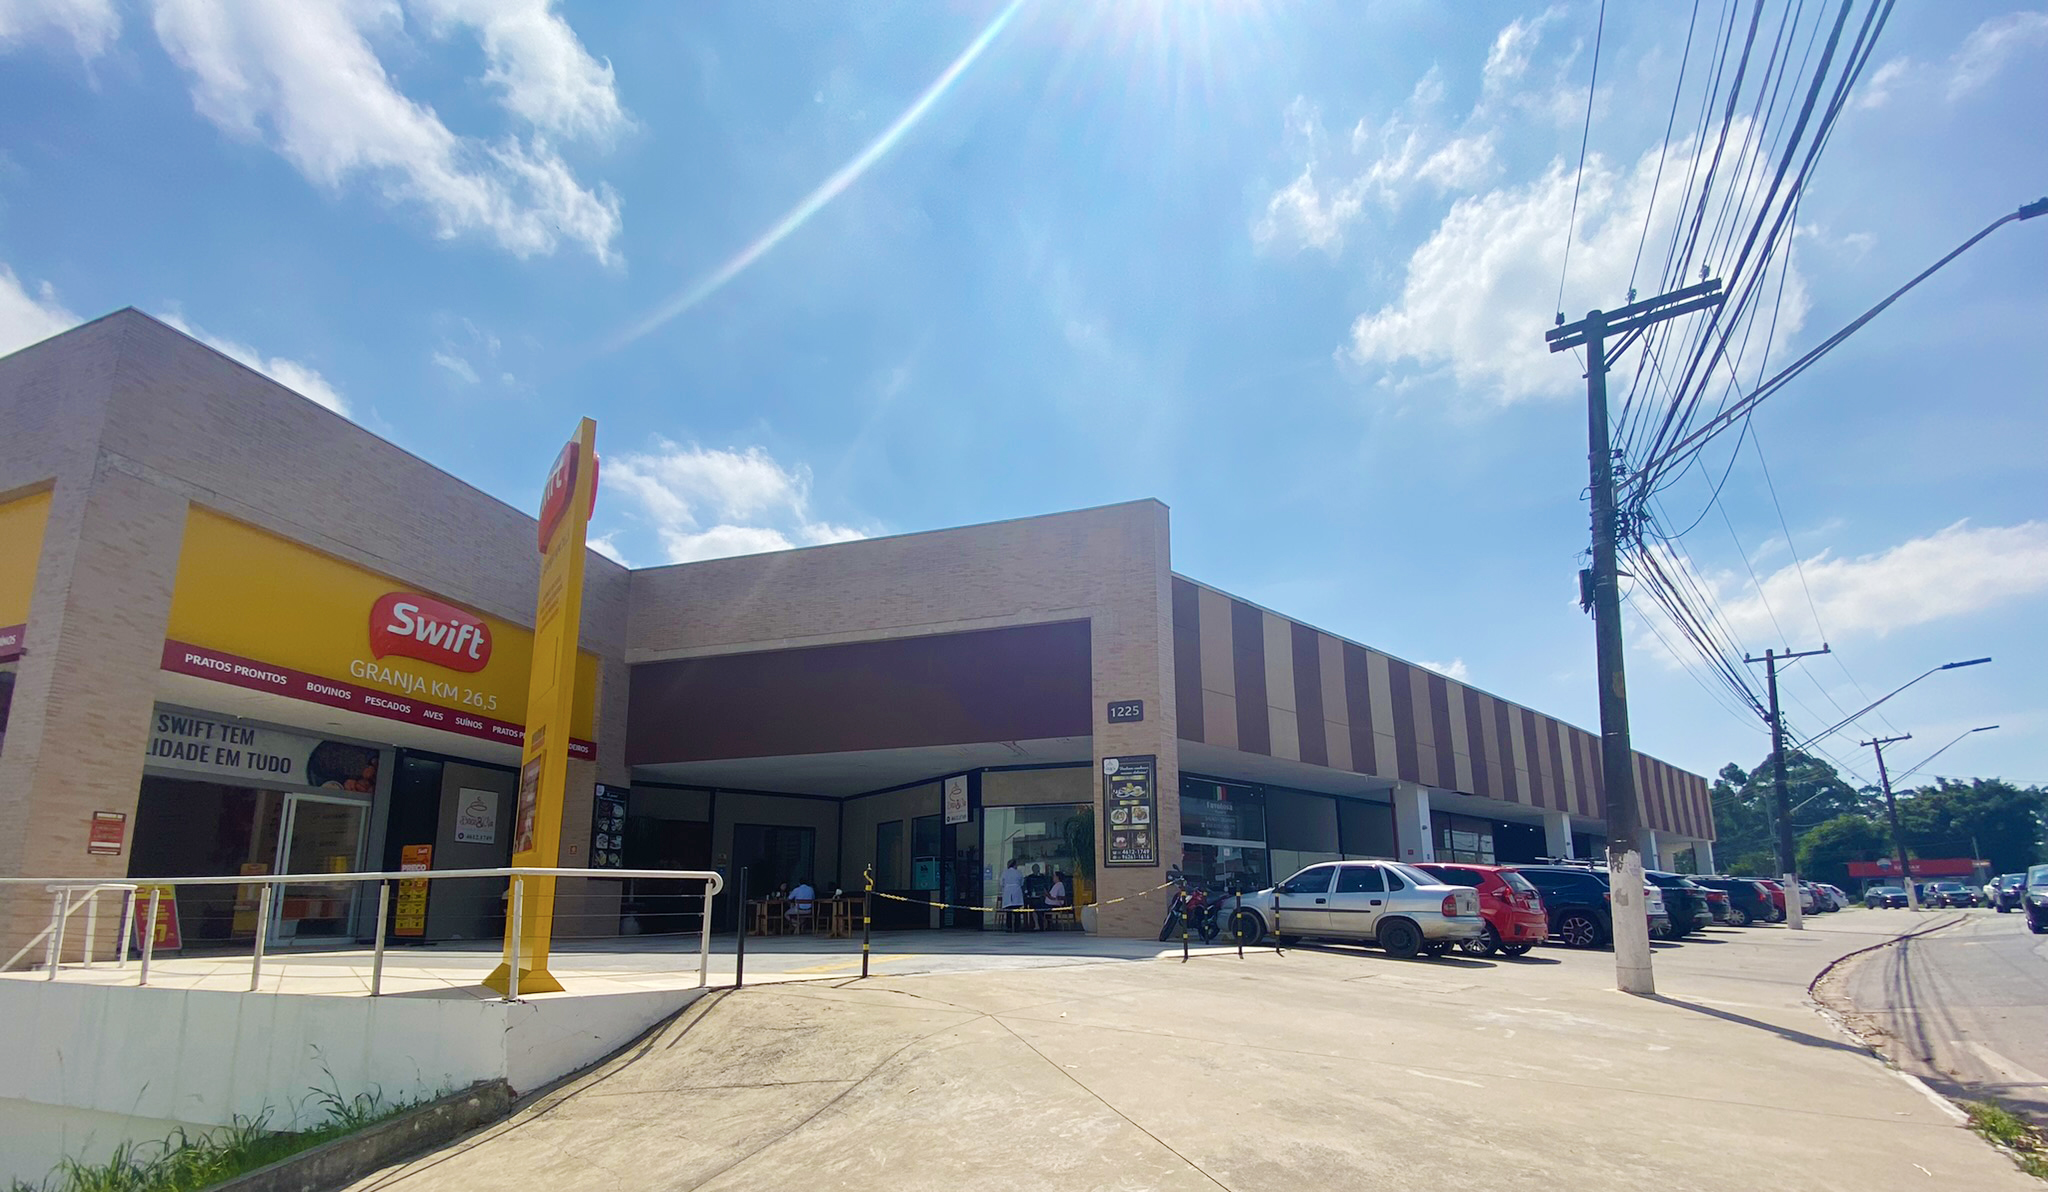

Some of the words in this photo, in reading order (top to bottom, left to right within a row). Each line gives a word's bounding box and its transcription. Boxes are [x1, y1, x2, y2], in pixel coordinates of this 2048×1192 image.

[386, 602, 485, 660] Swift
[184, 653, 232, 673] PRATOS
[234, 665, 288, 685] PRONTOS
[306, 682, 352, 700] BOVINOS
[364, 695, 412, 714] PESCADOS
[423, 709, 444, 721] AVES
[455, 716, 483, 730] SUÍNOS
[492, 725, 518, 738] PRATOS
[350, 659, 427, 695] GRANJA
[431, 680, 459, 702] KM
[462, 688, 498, 712] 26,5
[157, 714, 215, 739] SWIFT
[220, 724, 255, 746] TEM
[1110, 705, 1140, 718] 1225
[146, 738, 211, 763] IDADE
[215, 747, 240, 767] EM
[247, 752, 292, 774] TUDO
